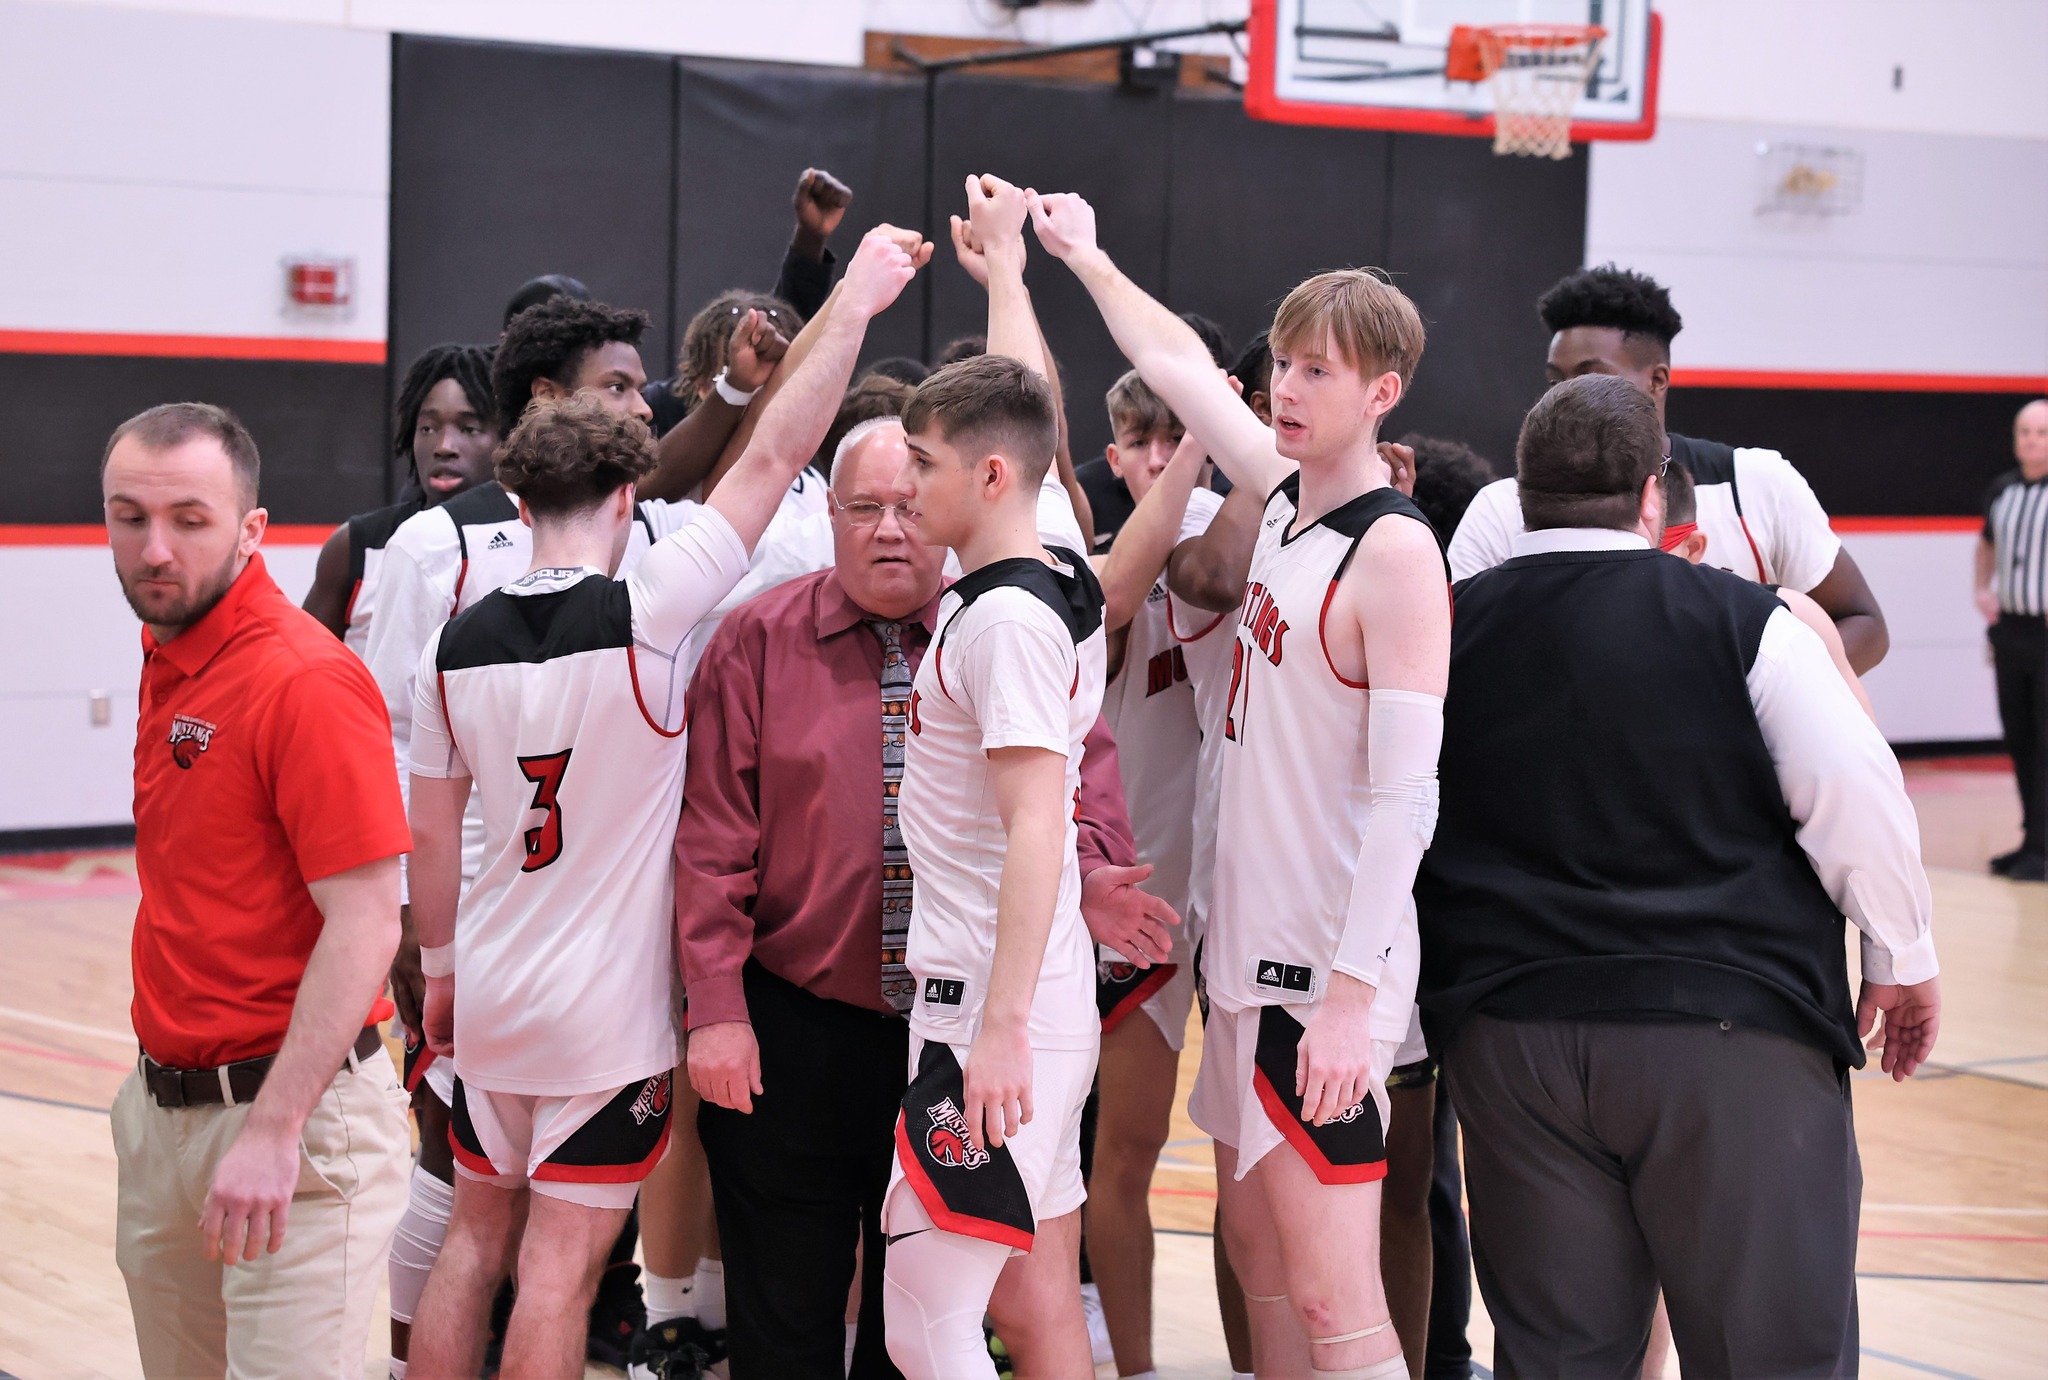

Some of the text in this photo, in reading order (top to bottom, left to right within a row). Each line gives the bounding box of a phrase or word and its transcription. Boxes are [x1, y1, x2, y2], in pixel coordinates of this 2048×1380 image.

[488, 541, 513, 550] adidas
[517, 748, 573, 873] 3
[1260, 974, 1280, 983] adidas
[1294, 973, 1300, 982] L
[948, 988, 954, 996] S
